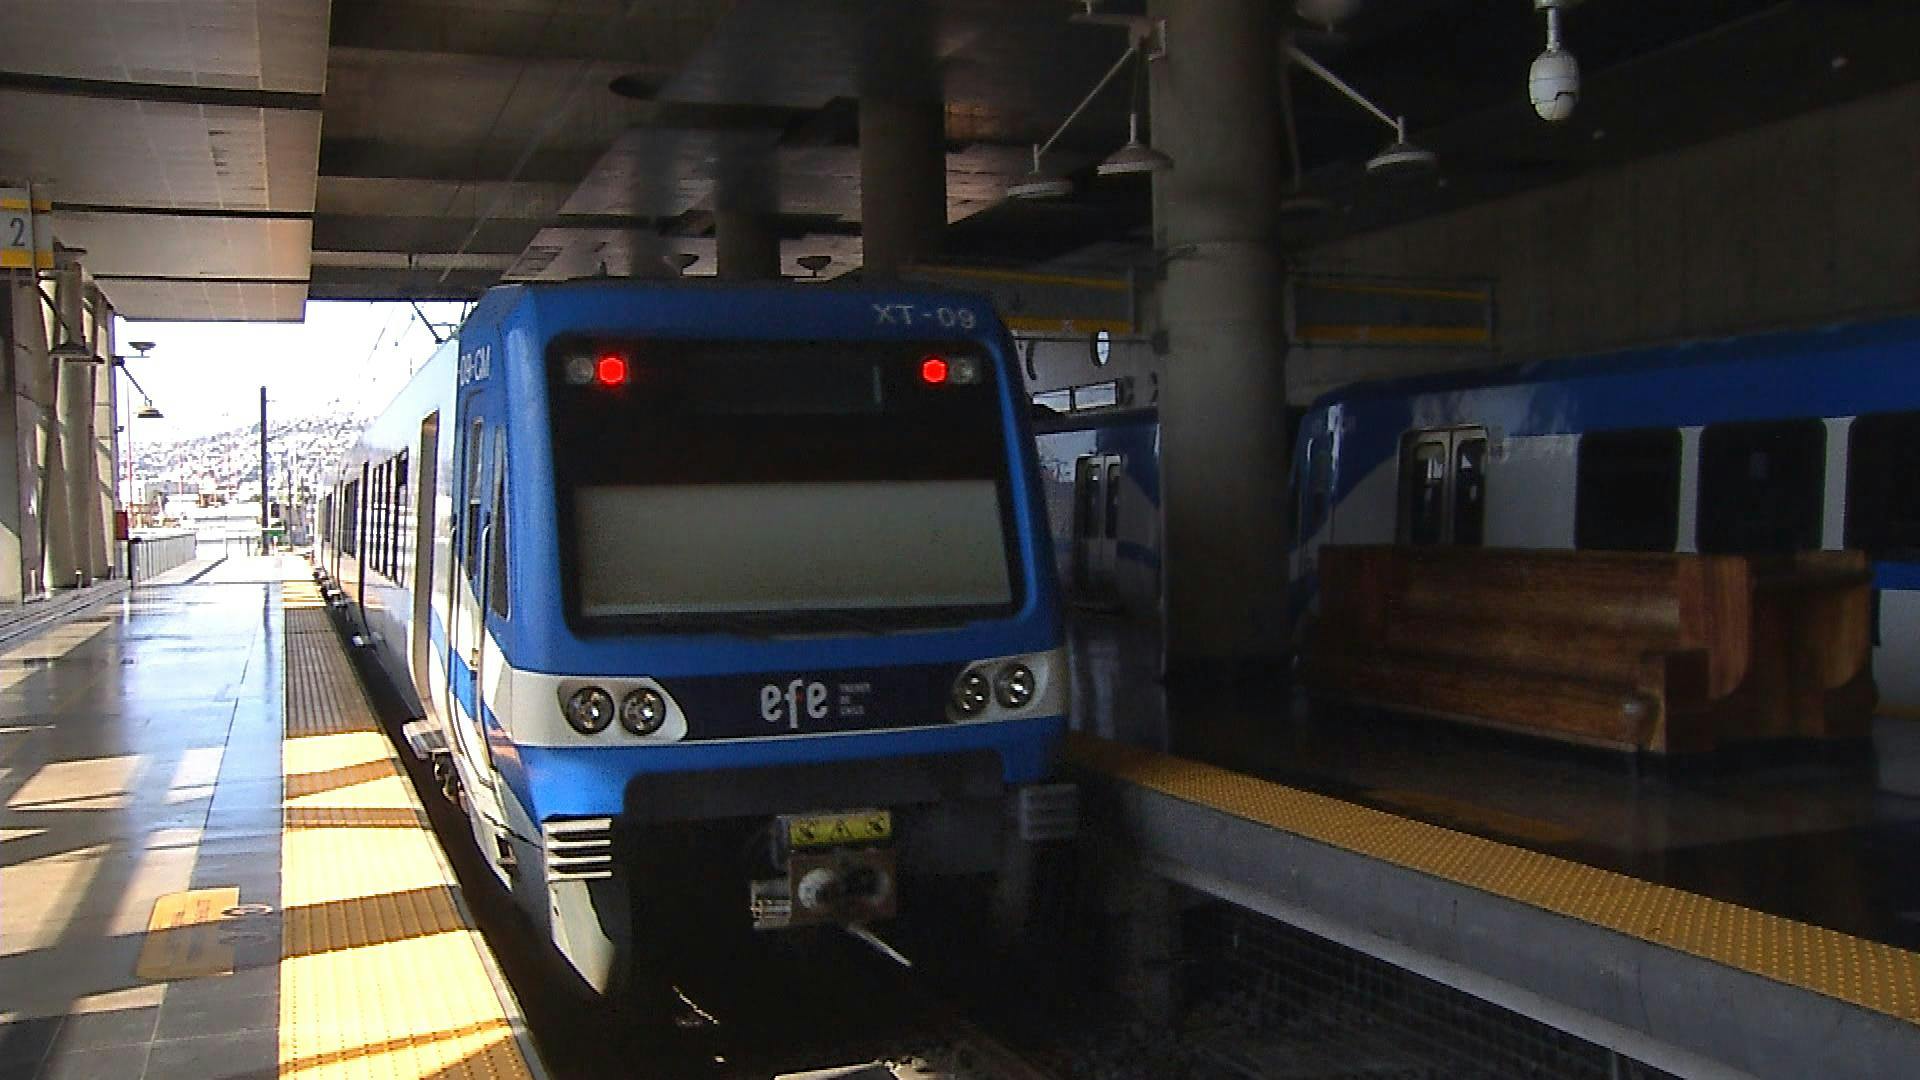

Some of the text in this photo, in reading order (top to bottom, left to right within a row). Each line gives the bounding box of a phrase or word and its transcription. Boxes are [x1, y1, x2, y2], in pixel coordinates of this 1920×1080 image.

[10, 217, 25, 247] 2
[871, 303, 977, 329] XT-09
[760, 679, 828, 730] efe
